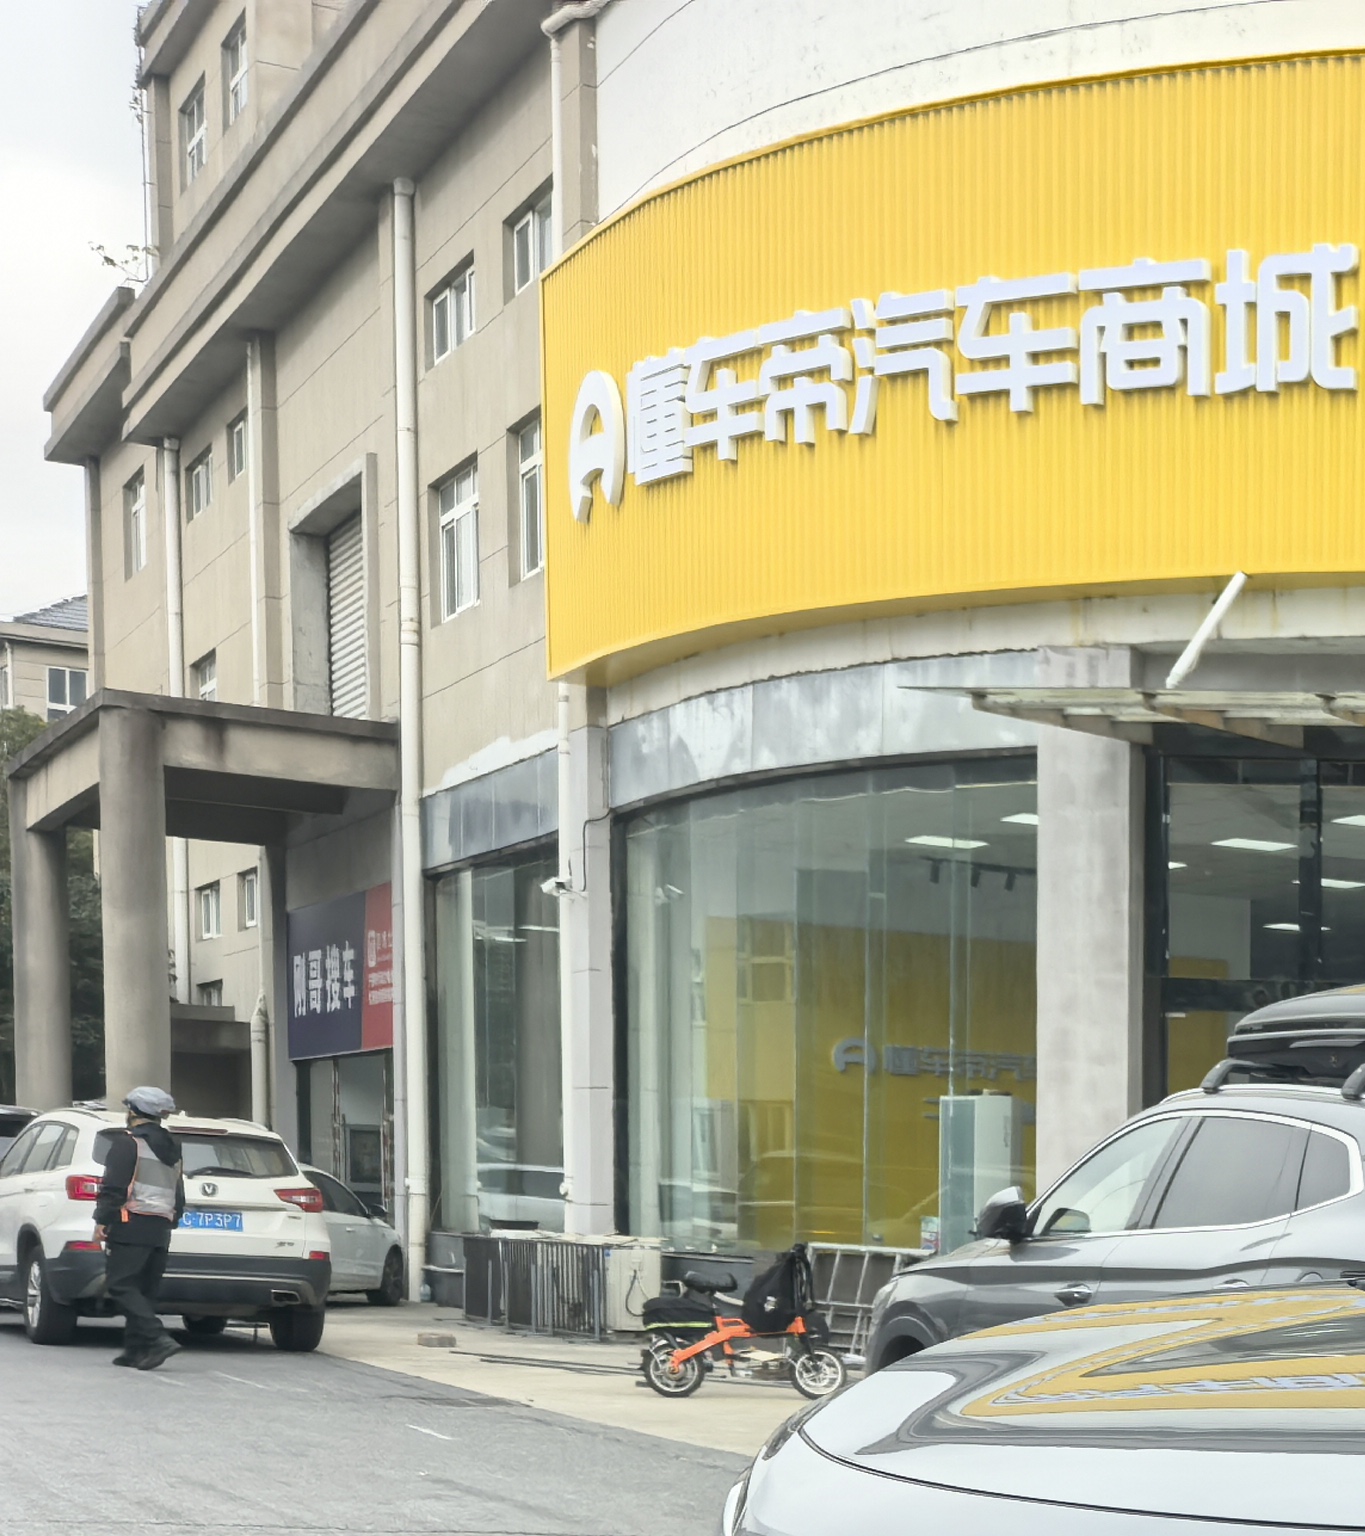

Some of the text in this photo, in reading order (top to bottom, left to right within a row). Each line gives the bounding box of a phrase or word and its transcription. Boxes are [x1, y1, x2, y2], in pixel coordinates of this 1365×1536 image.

[627, 243, 1359, 488] 懂车帝汽车商城
